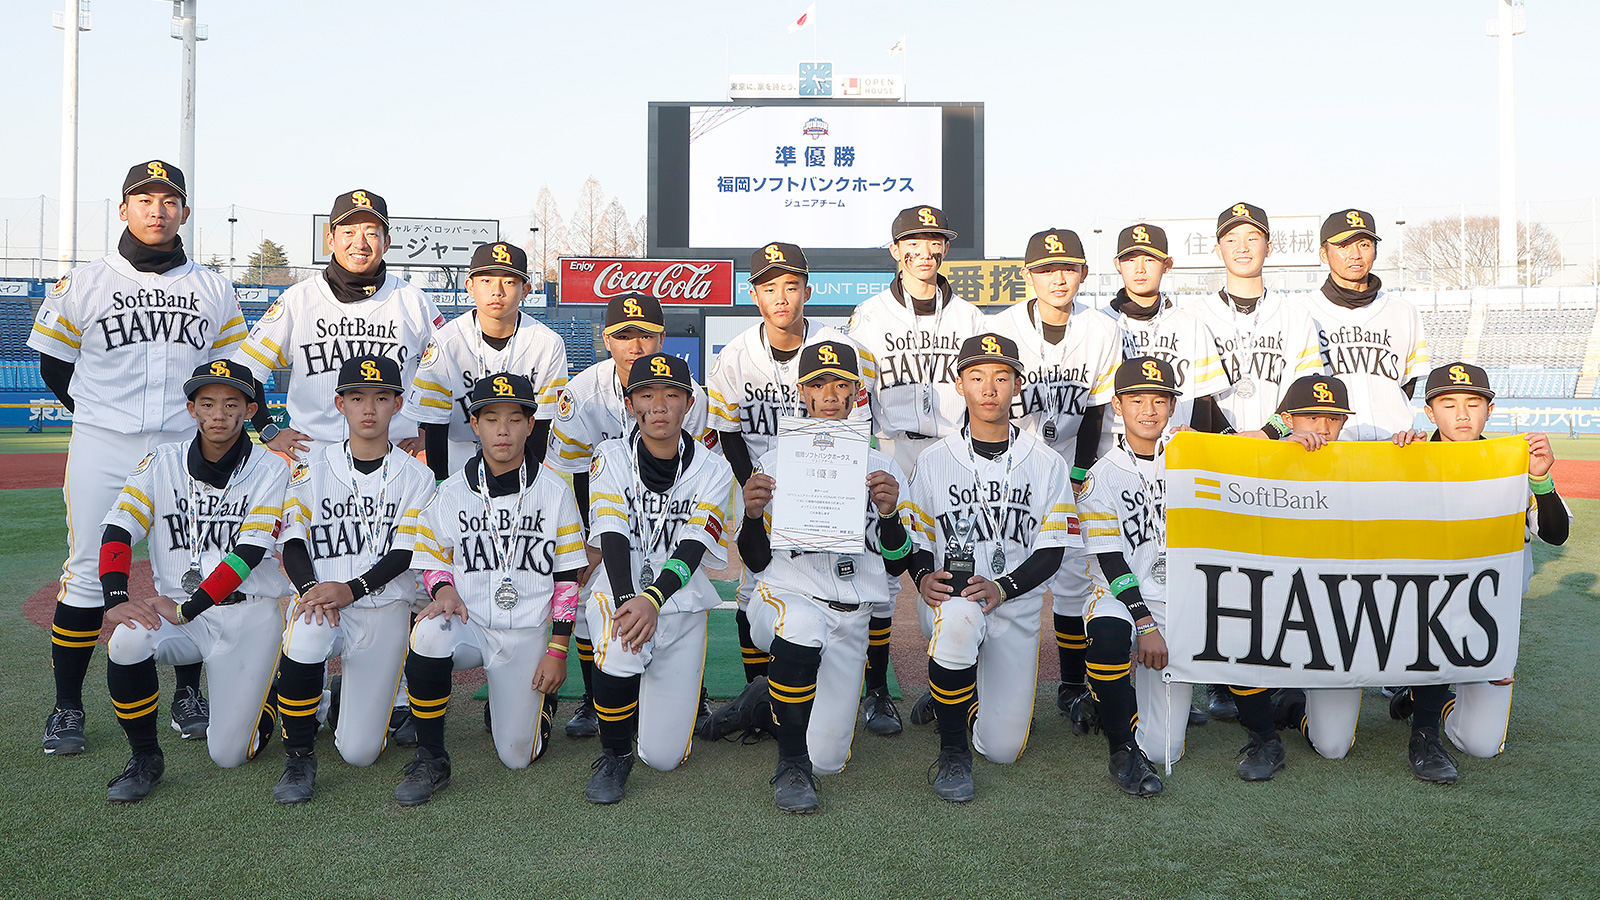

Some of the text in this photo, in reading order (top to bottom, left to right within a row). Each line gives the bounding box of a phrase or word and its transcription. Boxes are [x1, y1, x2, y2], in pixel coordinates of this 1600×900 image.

[775, 146, 856, 167] 準優勝
[717, 176, 914, 192] 福岡ソフトバンクホークス
[784, 199, 846, 208] ジュニアチーム
[569, 261, 595, 272] Enjoy
[593, 262, 717, 299] Coca-Cola
[113, 290, 199, 312] SoftBank
[98, 311, 209, 351] HAWKS
[316, 317, 399, 341] SoftBank
[1319, 325, 1393, 349] SoftBank
[880, 353, 957, 390] HAWK
[1228, 482, 1329, 510] SoftBank
[1192, 565, 1500, 673] HAWKS
